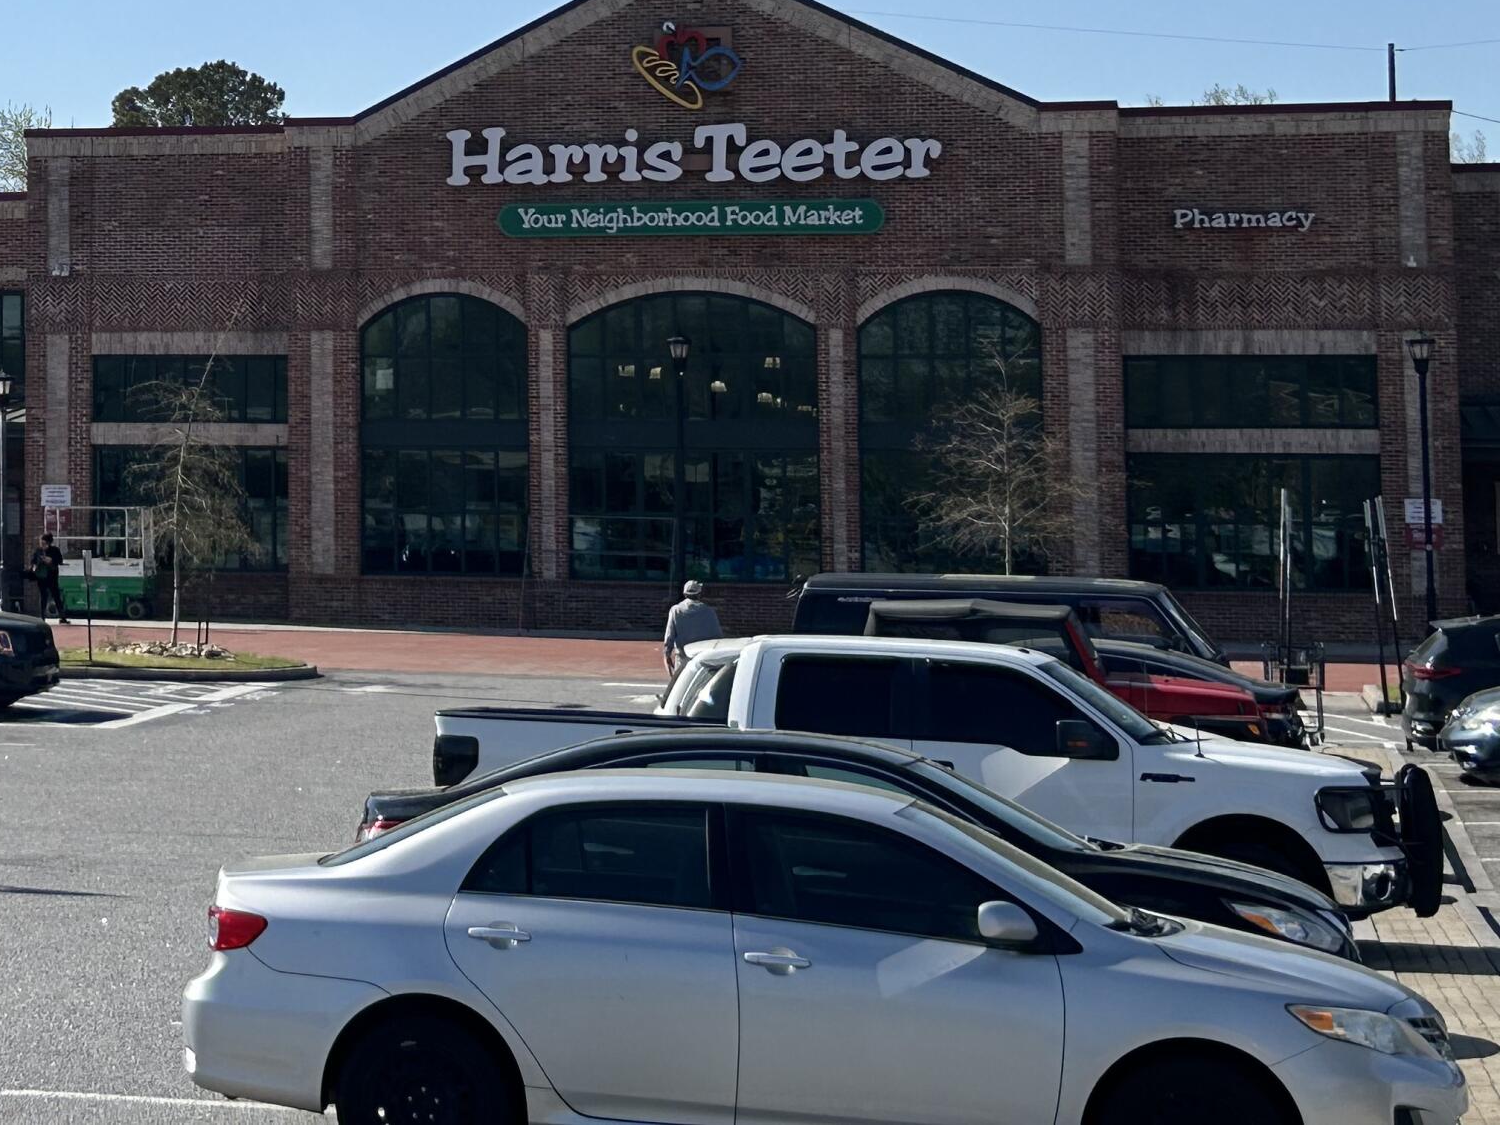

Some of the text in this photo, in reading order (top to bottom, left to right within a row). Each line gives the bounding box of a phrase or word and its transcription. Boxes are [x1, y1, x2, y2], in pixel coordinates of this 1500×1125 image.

[446, 123, 942, 186] Harris Teeter
[517, 205, 864, 233] Your Neighborhood Food Market
[1173, 208, 1316, 232] Pharmacy
